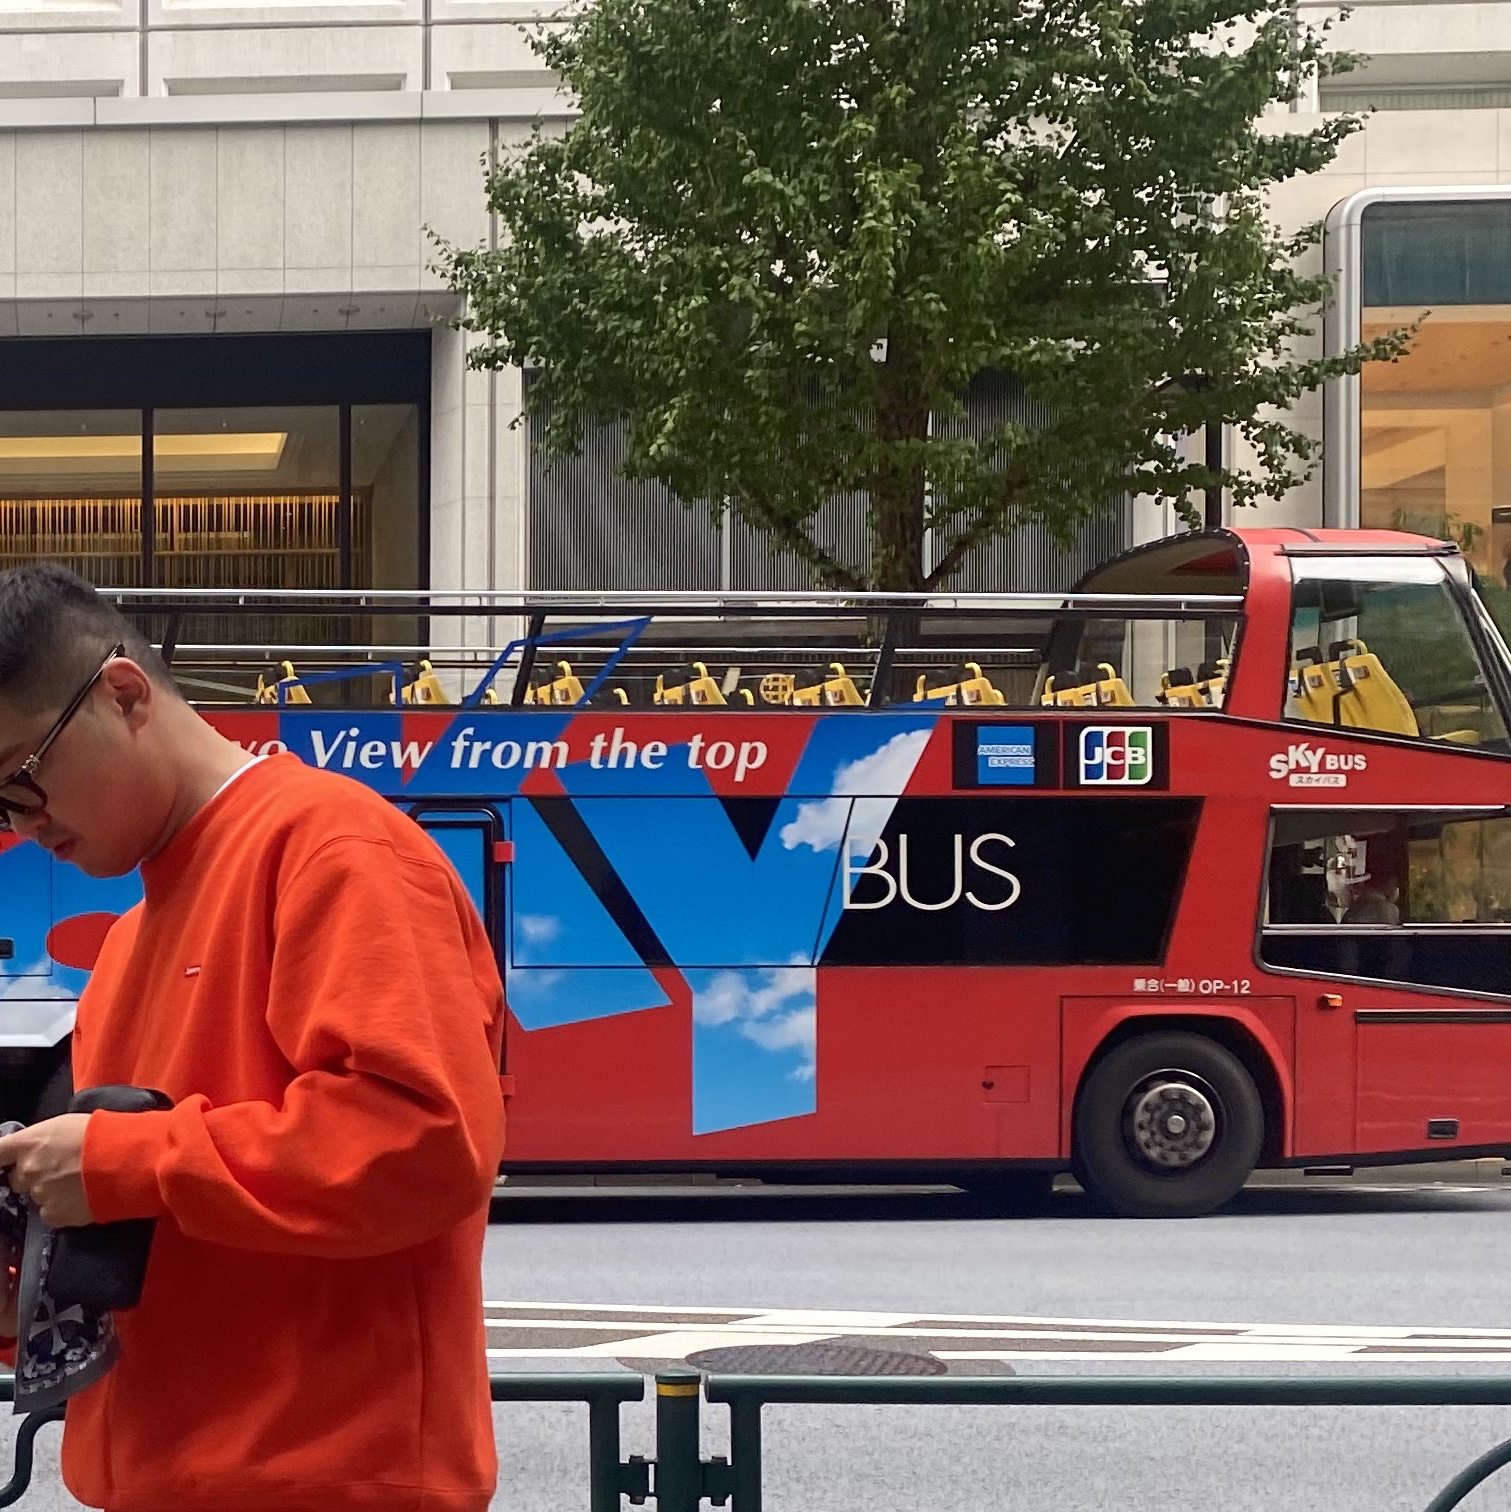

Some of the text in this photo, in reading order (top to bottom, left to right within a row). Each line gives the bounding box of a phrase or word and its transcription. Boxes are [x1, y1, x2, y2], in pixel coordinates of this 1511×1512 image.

[310, 727, 433, 769] View
[450, 727, 568, 769] from
[589, 727, 668, 768] the
[687, 733, 768, 781] top
[978, 745, 1031, 755] AMERICAN
[1084, 746, 1146, 765] JCB
[1269, 743, 1367, 779] SKY BUS
[843, 833, 1021, 911] BUS
[1198, 979, 1251, 994] OP-12
